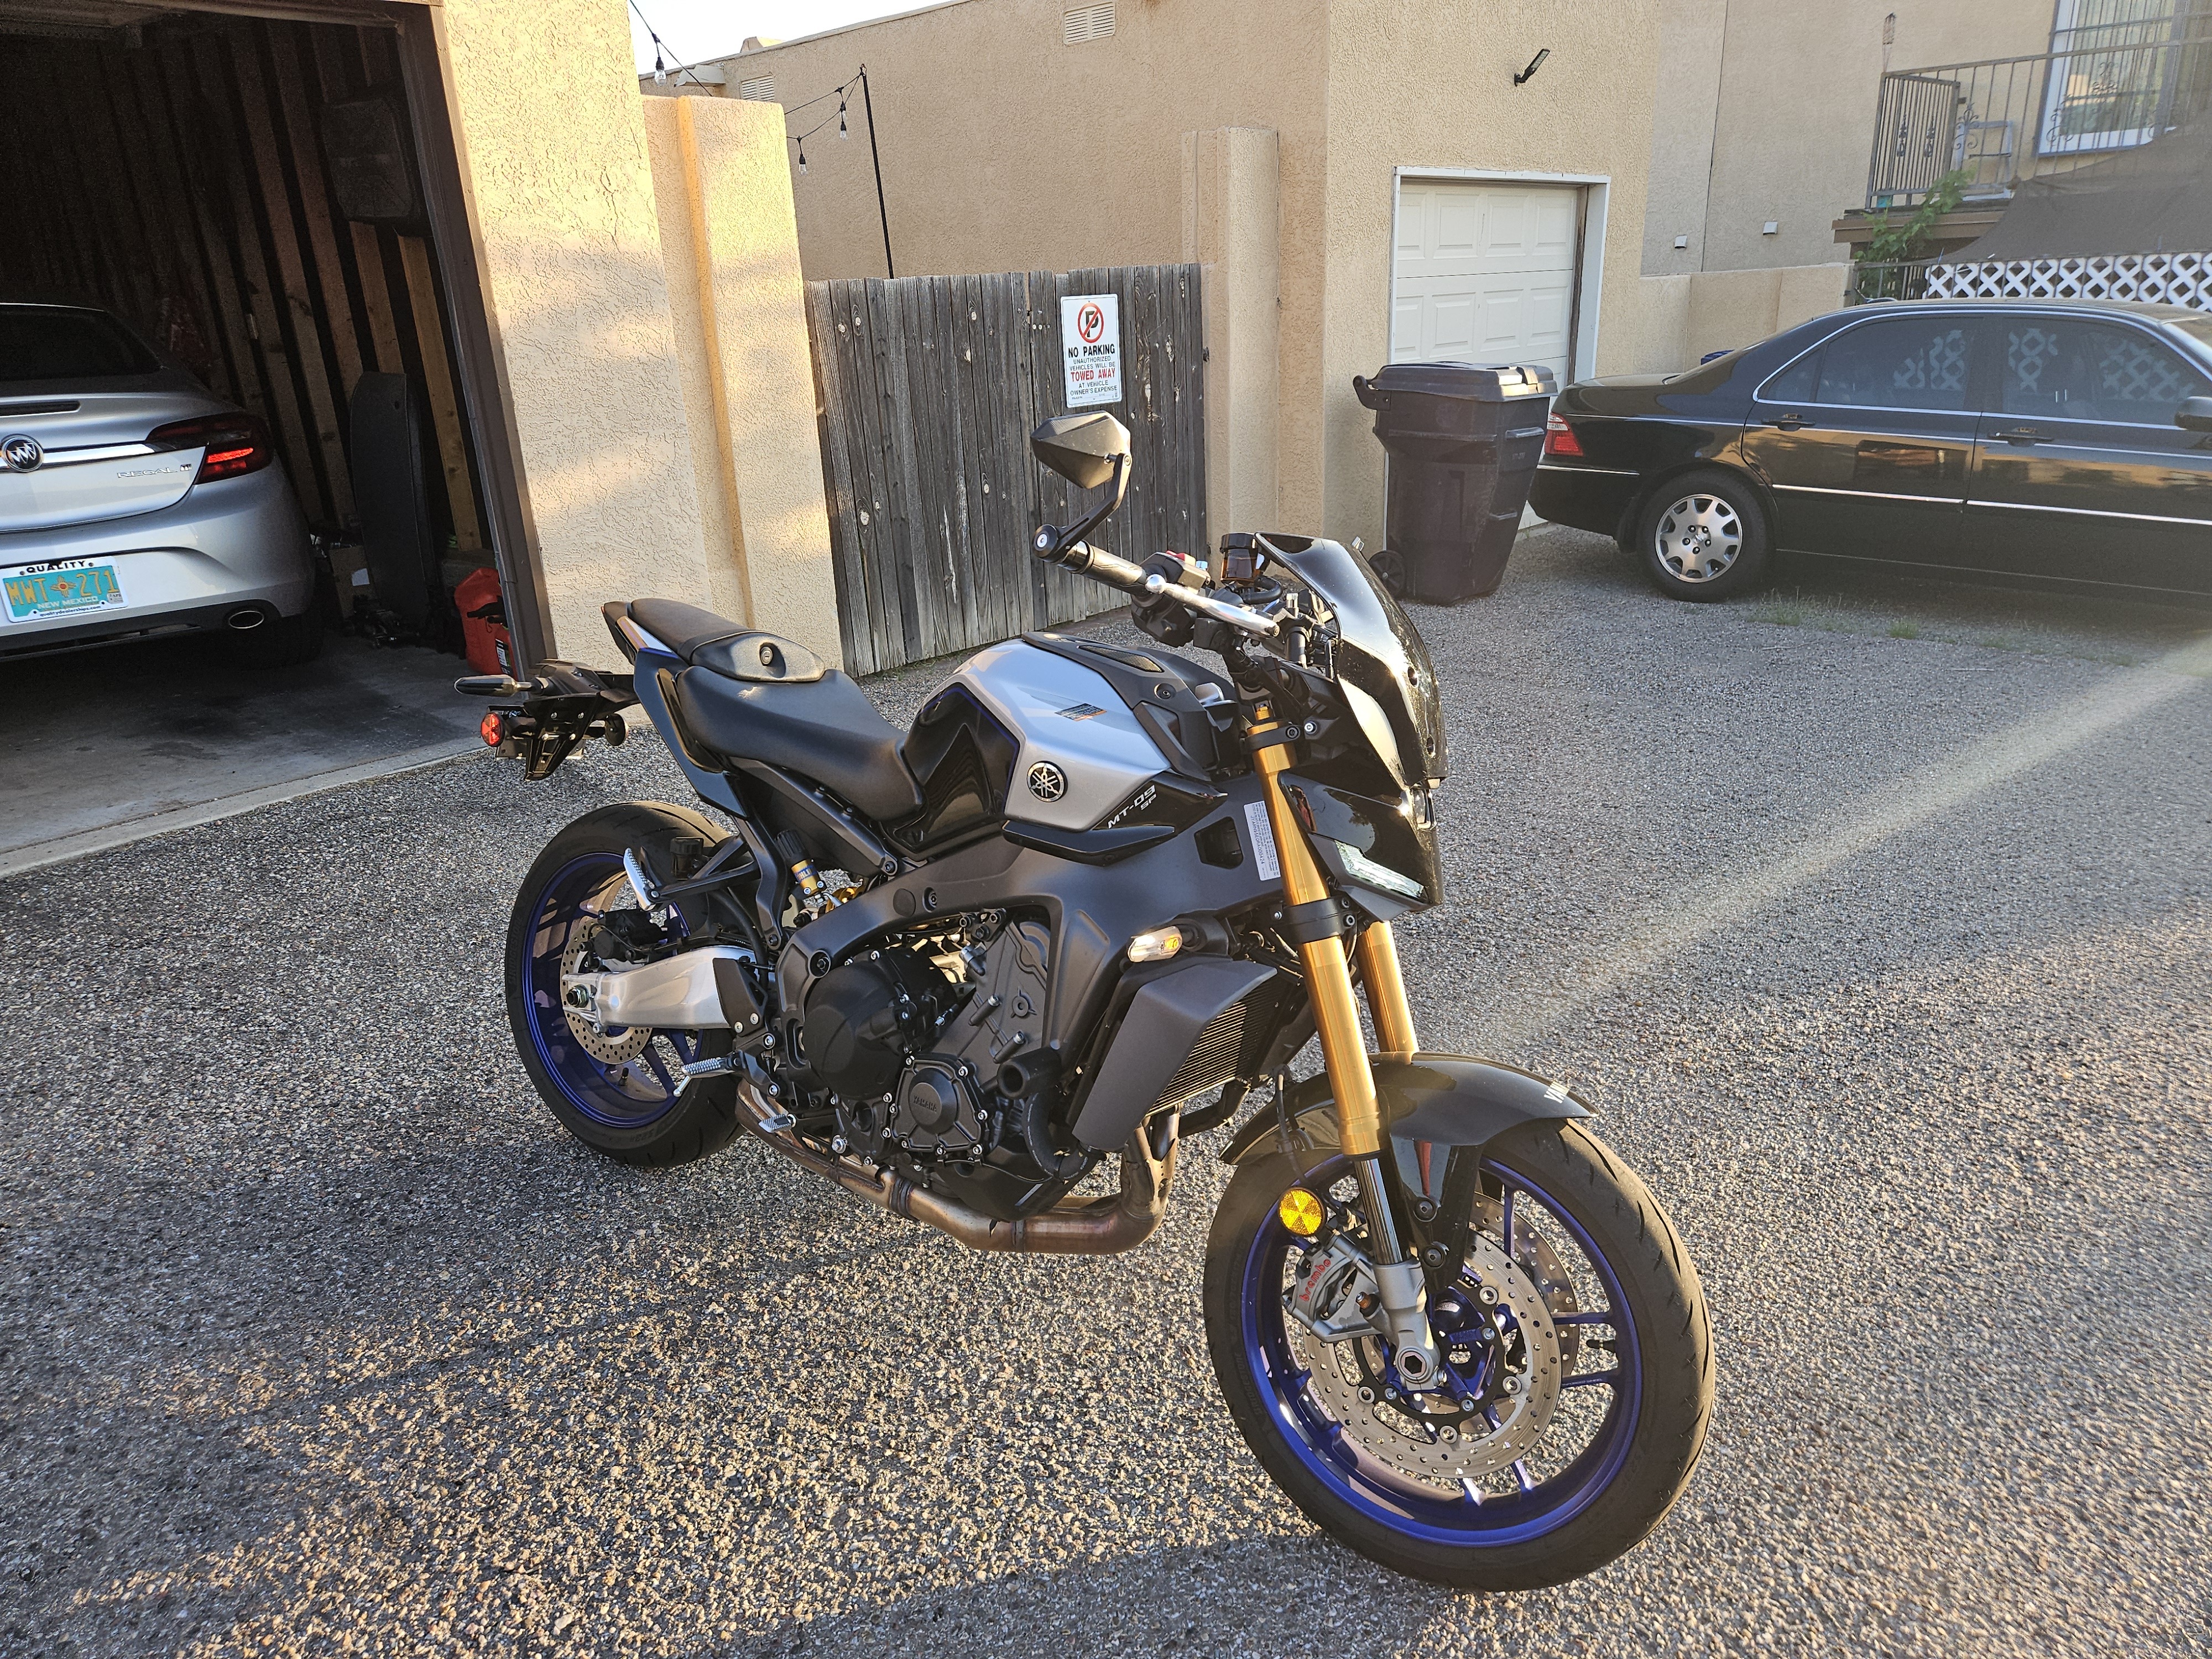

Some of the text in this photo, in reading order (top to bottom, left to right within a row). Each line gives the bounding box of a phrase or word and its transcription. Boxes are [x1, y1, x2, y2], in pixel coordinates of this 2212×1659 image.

[1068, 343, 1115, 358] NO PARKING
[1073, 356, 1111, 364] UNAUTHORIZED
[1071, 368, 1116, 382] TOWED AWAY
[1070, 387, 1094, 396] OWNER'S
[117, 467, 178, 478] REGAL
[26, 560, 86, 573] QUALITY
[5, 570, 119, 607] MWT 271
[36, 601, 60, 609] NEW
[62, 596, 99, 606] MEXICO
[40, 606, 101, 617] qualitydealerships.com
[1108, 785, 1155, 829] MT-09
[1140, 794, 1156, 811] SP
[913, 1095, 937, 1112] YAMAHA
[1299, 1259, 1331, 1302] brembo
